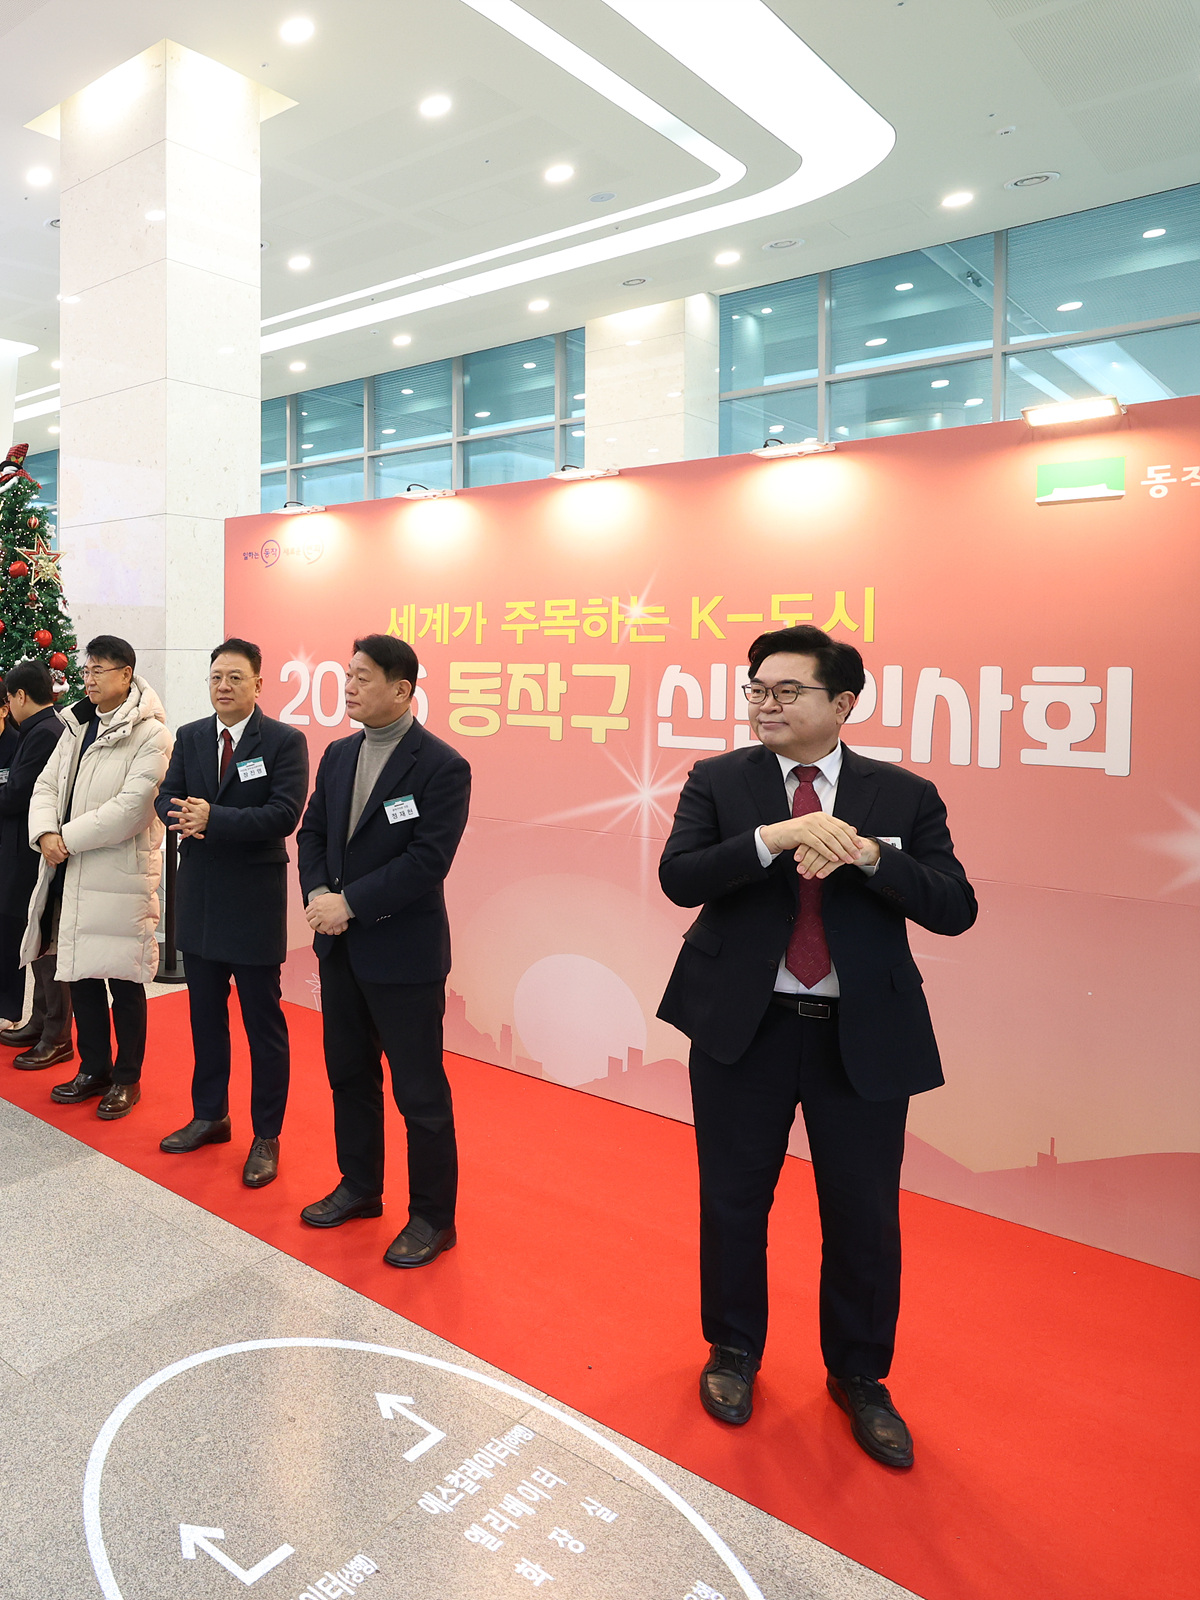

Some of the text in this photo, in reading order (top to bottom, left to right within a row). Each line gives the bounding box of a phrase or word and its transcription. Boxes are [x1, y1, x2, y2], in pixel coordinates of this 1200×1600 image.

[385, 600, 488, 646] 세계가
[500, 595, 671, 645] 주목하는
[447, 660, 632, 744] 동작구
[656, 663, 1134, 777] 신인사회
[463, 1465, 568, 1552] 엘리베이터
